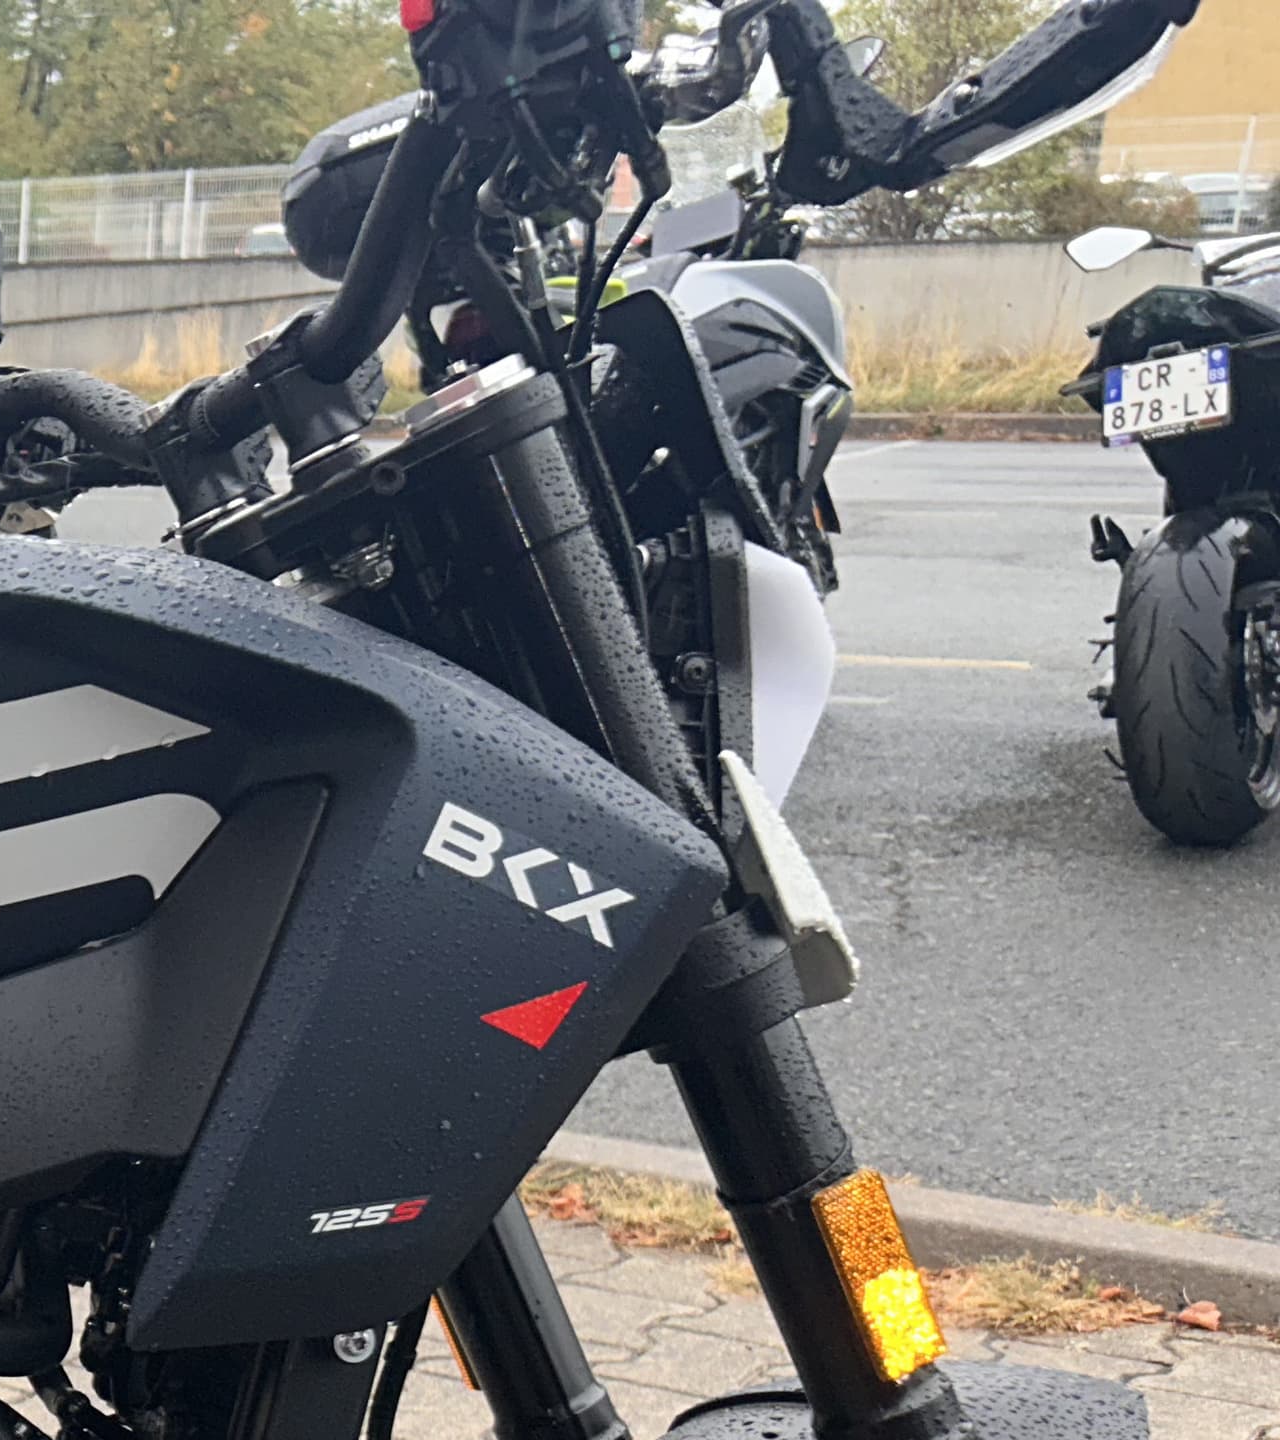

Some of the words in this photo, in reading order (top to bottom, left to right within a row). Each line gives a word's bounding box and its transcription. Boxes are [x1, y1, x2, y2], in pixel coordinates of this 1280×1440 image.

[1111, 388, 1218, 430] 878-LX
[422, 801, 636, 949] BKX
[310, 1199, 429, 1233] 125S
